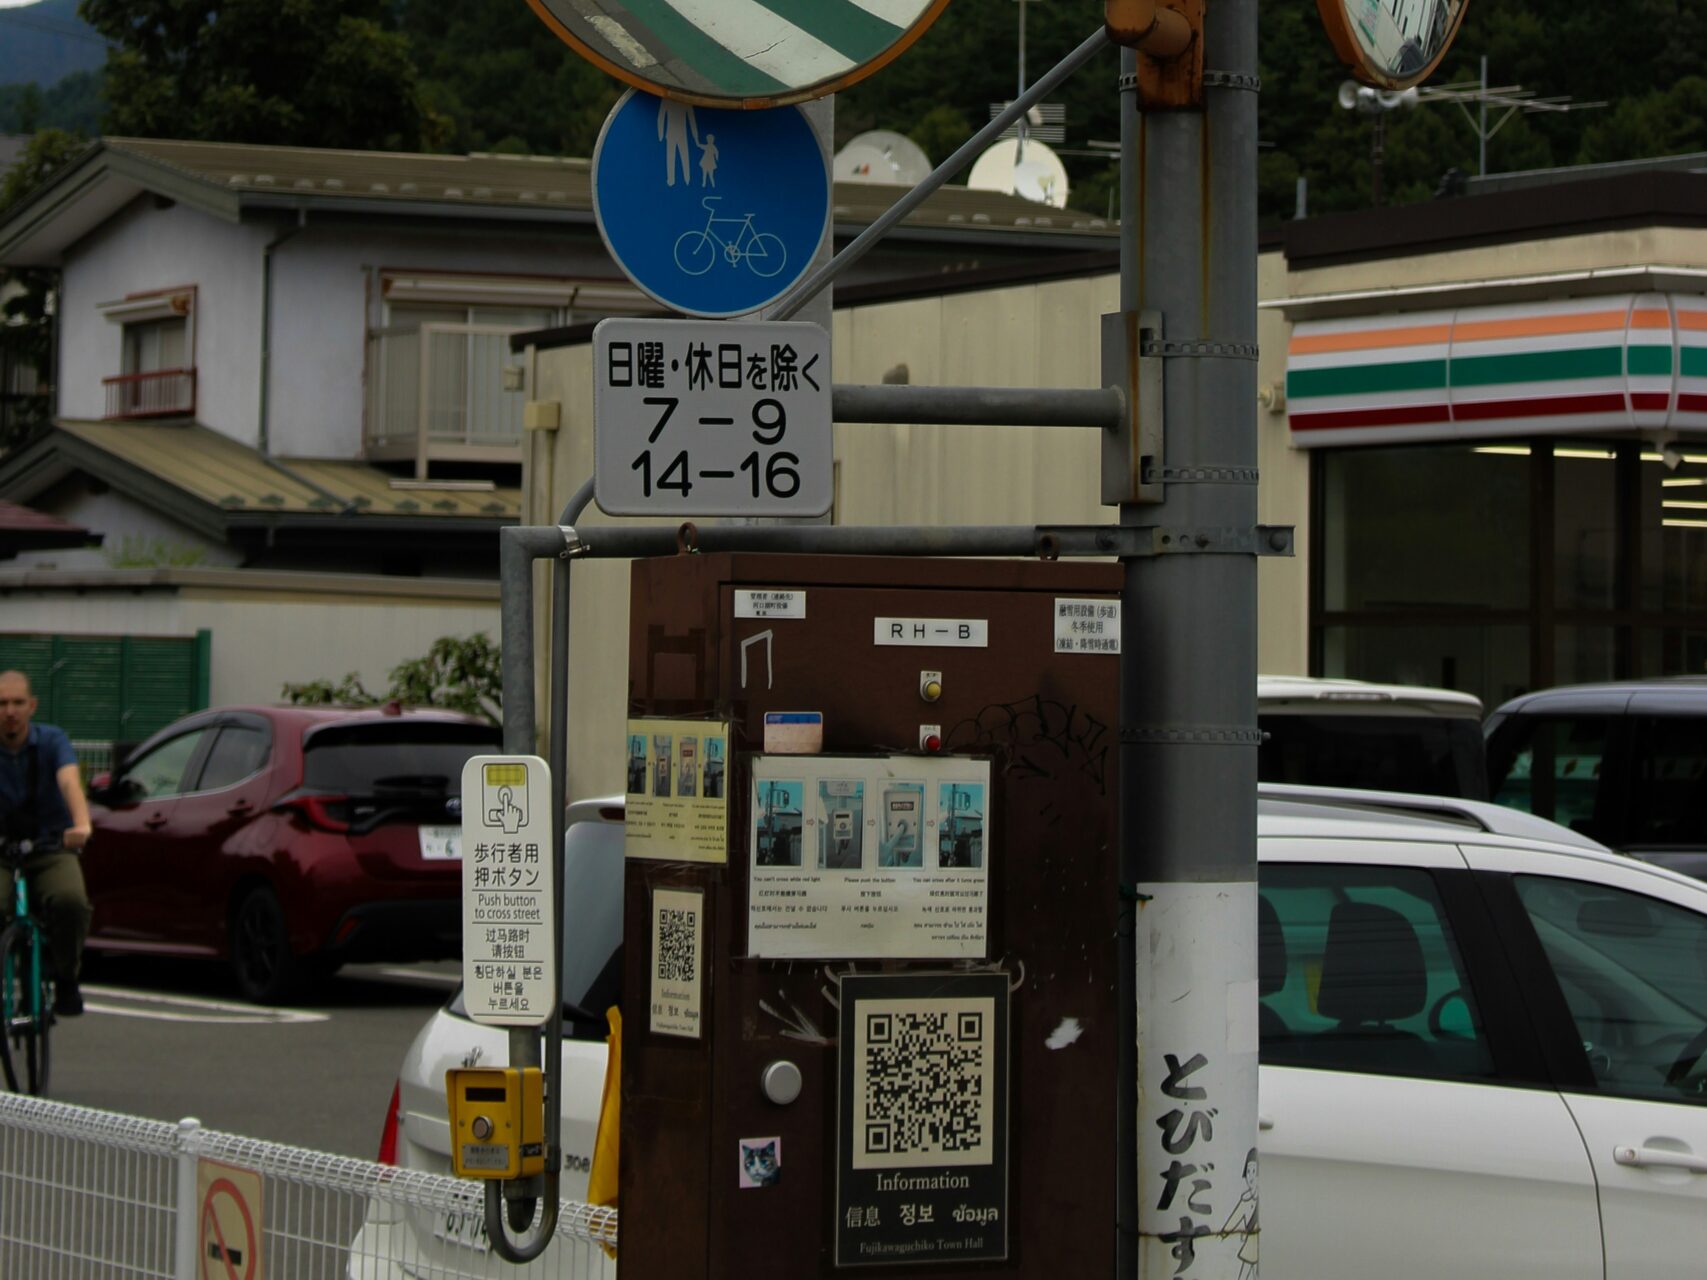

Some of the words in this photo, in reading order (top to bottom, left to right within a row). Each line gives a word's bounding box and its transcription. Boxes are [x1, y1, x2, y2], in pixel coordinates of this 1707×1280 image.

[608, 341, 821, 392] 日曜・休日を除く
[474, 842, 539, 864] 歩行者用
[474, 866, 540, 888] 押ボタン
[478, 893, 501, 907] Push
[503, 894, 536, 907] button
[475, 908, 486, 920] to
[486, 910, 511, 920] cross
[513, 909, 540, 921] street
[485, 928, 530, 944] 过马路时
[491, 944, 525, 960] 请按钮
[474, 965, 517, 981] 횡단하실
[522, 966, 543, 981] 분은
[493, 981, 524, 997] 버튼을
[487, 997, 530, 1012] 누르세요
[1155, 1052, 1219, 1280] とびだす
[876, 1170, 971, 1192] Information
[845, 1205, 881, 1229] 信息
[899, 1203, 935, 1226] 정보
[951, 1202, 999, 1227] ข้อมูล
[859, 1239, 936, 1256] Fujikawaguchiko
[935, 1238, 963, 1251] Town
[964, 1236, 984, 1249] Hall
